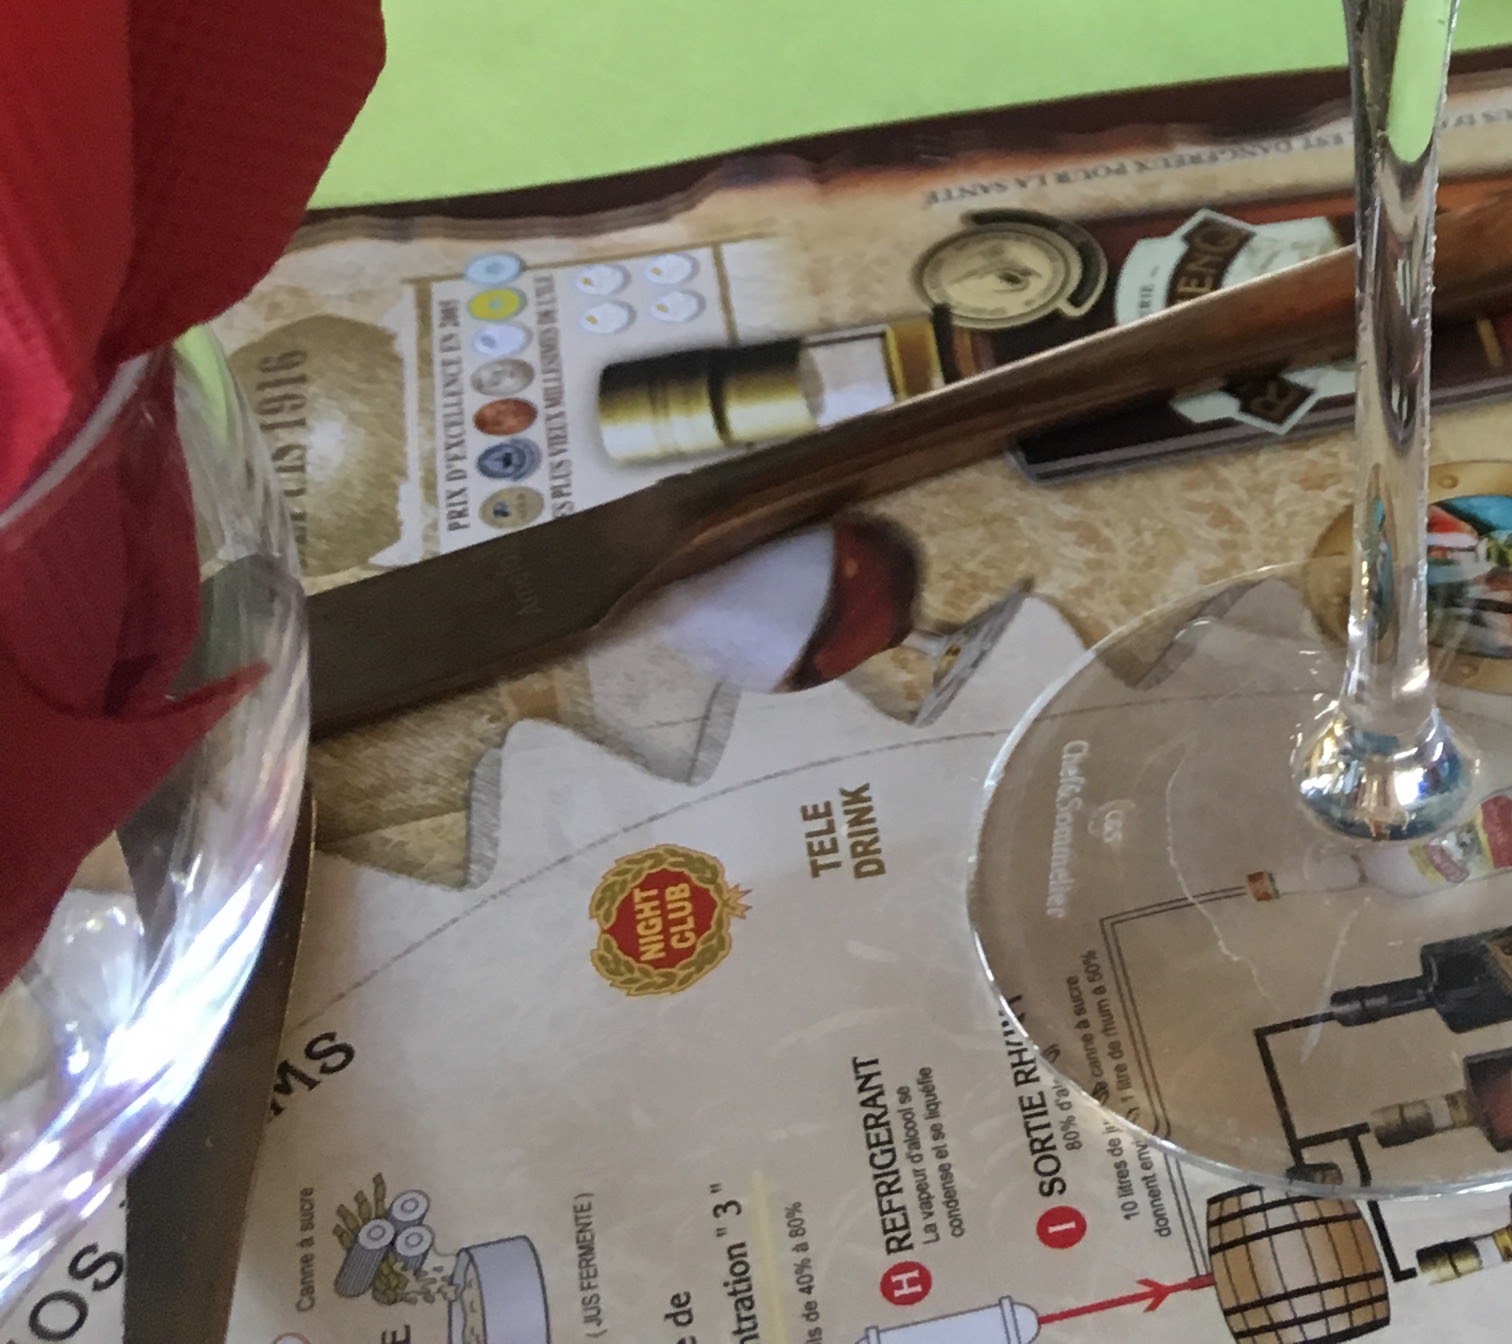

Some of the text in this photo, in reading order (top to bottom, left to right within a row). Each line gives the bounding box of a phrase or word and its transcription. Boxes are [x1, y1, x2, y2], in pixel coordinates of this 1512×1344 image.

[446, 486, 470, 531] PRIX
[804, 800, 841, 879] TELE
[839, 782, 886, 879] DRINK
[632, 888, 664, 962] NIGHT
[663, 881, 696, 952] CLUB
[1067, 975, 1088, 1013] sucre
[1081, 1033, 1102, 1078] canne
[852, 1056, 914, 1255] REFRIGERANT
[930, 1123, 945, 1141] se
[932, 1144, 949, 1160] et
[1017, 1090, 1066, 1197] SORTIE
[1060, 1114, 1083, 1151] 80%
[896, 1085, 941, 1244] La vapeur d'alcool se
[1114, 1160, 1134, 1201] litres
[299, 1186, 315, 1230] sucre
[938, 1163, 965, 1238] condense
[1122, 1204, 1140, 1221] 10
[1141, 1174, 1172, 1238] donnent
[296, 1253, 316, 1312] Canne
[664, 1291, 694, 1327] de
